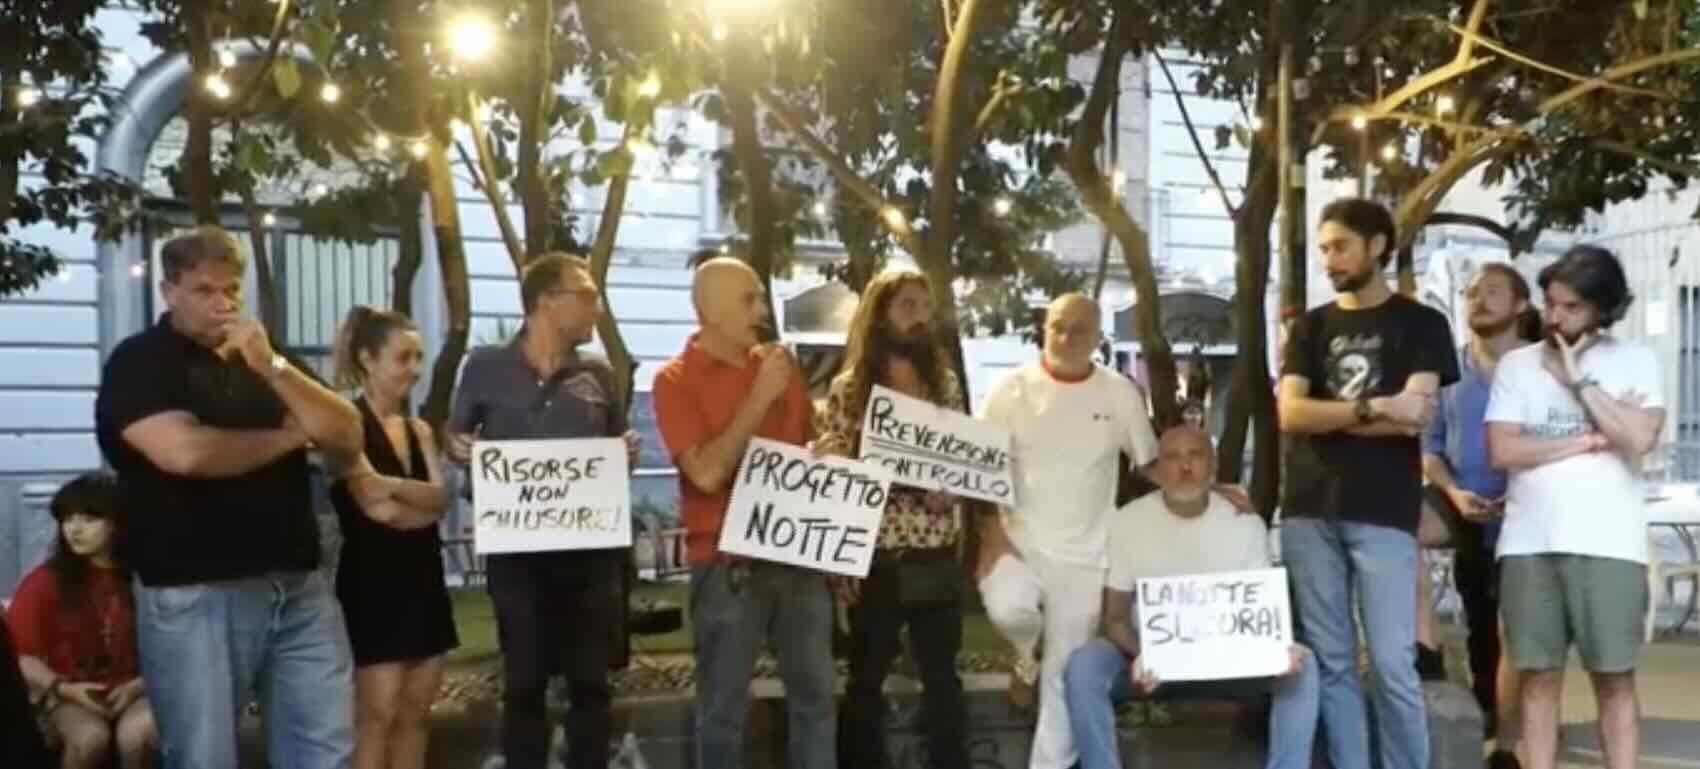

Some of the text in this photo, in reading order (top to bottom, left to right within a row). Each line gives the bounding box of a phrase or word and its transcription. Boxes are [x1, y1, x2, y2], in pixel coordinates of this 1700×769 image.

[479, 448, 606, 483] RISORSE
[743, 447, 884, 509] PROGETTO
[518, 483, 570, 503] NON
[744, 503, 870, 564] NOTTE
